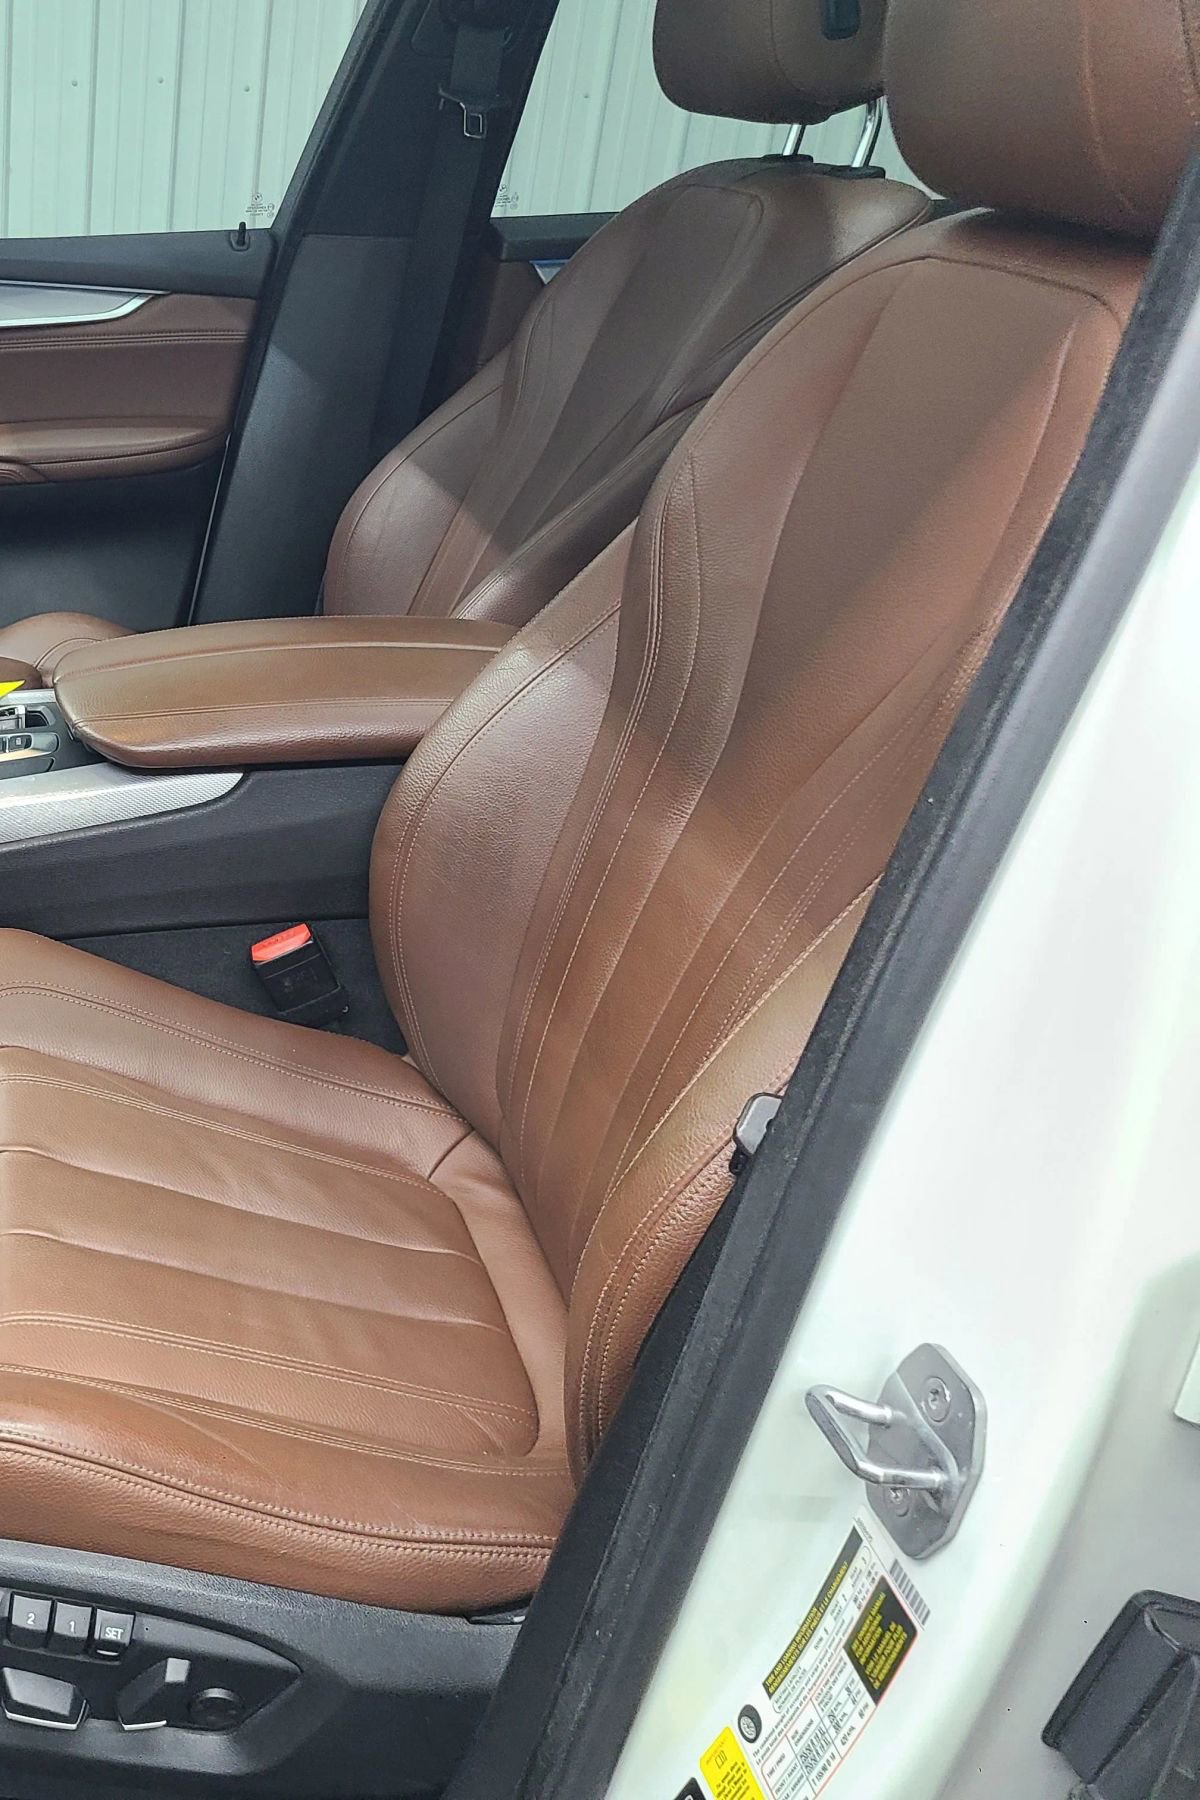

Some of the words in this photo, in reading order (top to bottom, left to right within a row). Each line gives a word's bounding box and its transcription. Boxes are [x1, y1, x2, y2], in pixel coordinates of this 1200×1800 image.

[27, 1613, 36, 1625] 2
[68, 1620, 76, 1633] 1
[105, 1627, 124, 1640] SET
